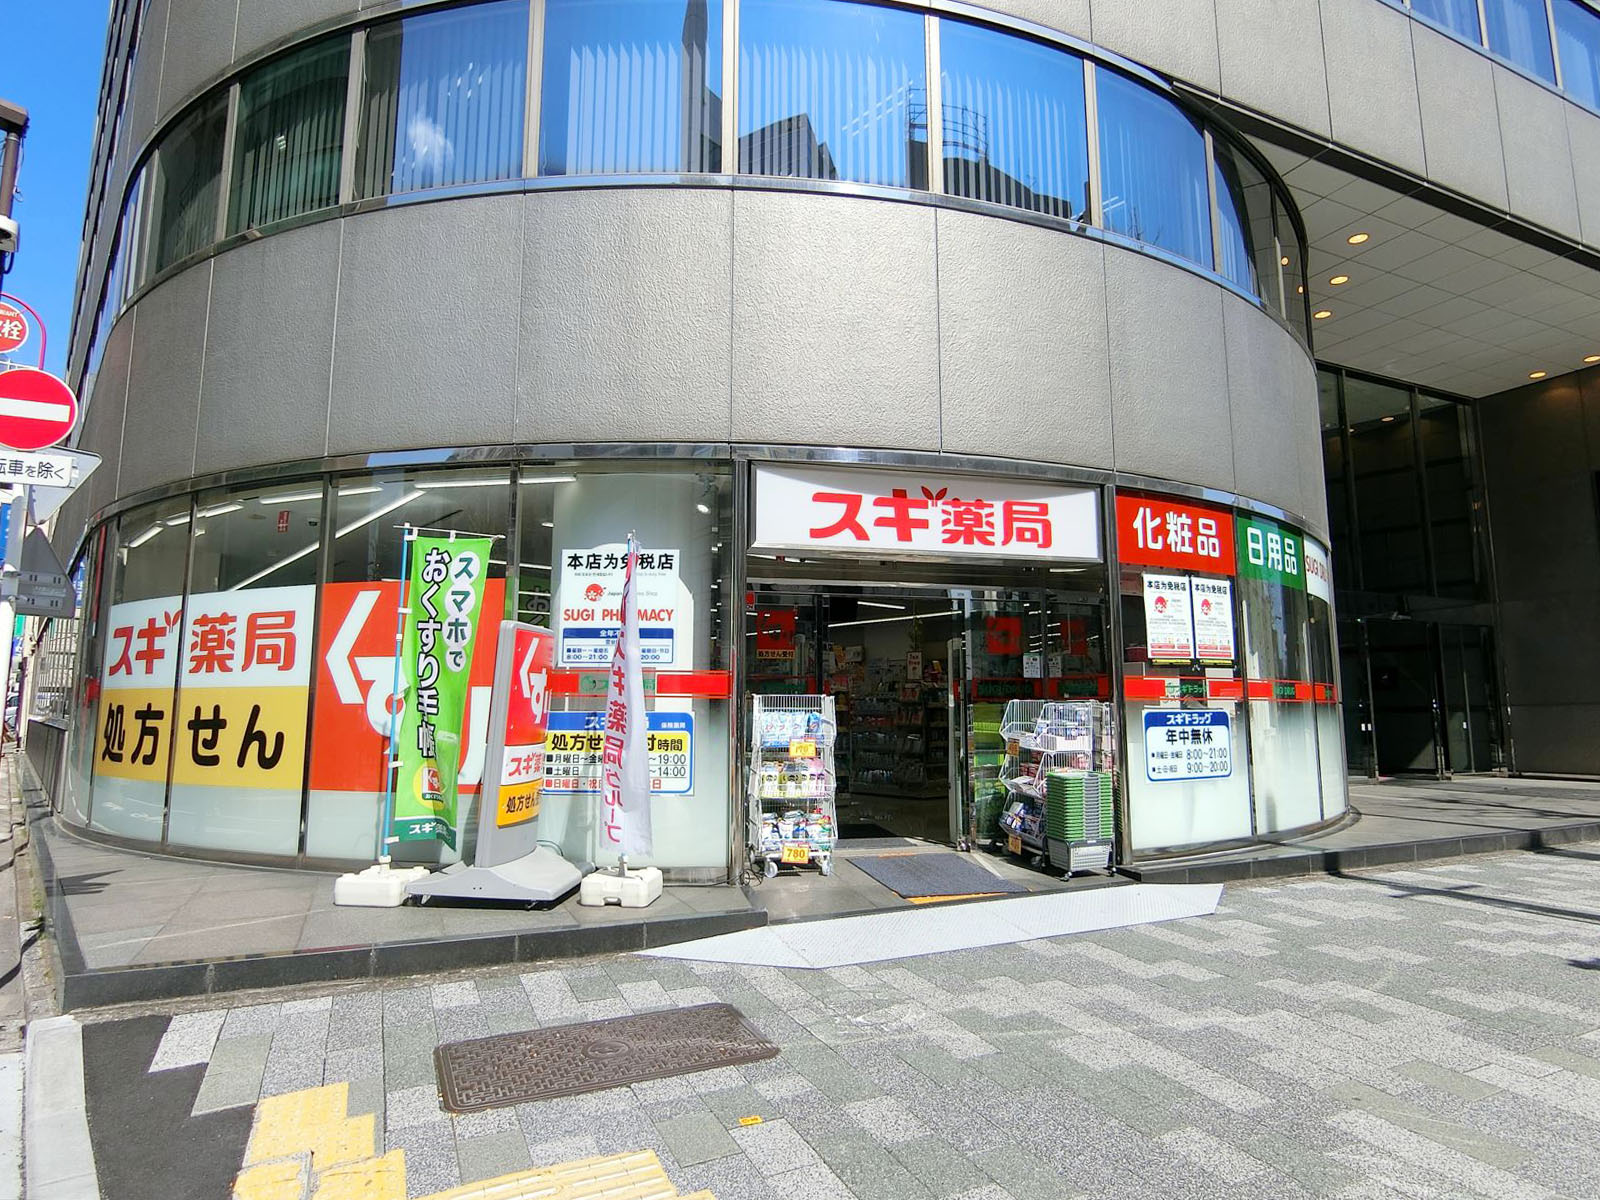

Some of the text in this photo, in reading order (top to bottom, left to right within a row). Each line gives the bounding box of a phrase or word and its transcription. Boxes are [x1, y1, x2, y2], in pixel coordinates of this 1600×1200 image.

[809, 485, 1053, 549] スギ薬局
[1132, 506, 1220, 558] 化粧品
[1246, 526, 1297, 576] 日用品
[446, 557, 474, 668] スマホで
[563, 608, 595, 621] SUGI
[109, 610, 296, 676] スギ薬局
[1166, 712, 1213, 725] スギドラッグ
[102, 702, 285, 770] 処方せん
[1166, 728, 1213, 745] 年中無休
[649, 755, 687, 765] ～19:00
[554, 766, 580, 777] 土曜日
[649, 766, 687, 777] ～14:00
[786, 848, 806, 860] 780
